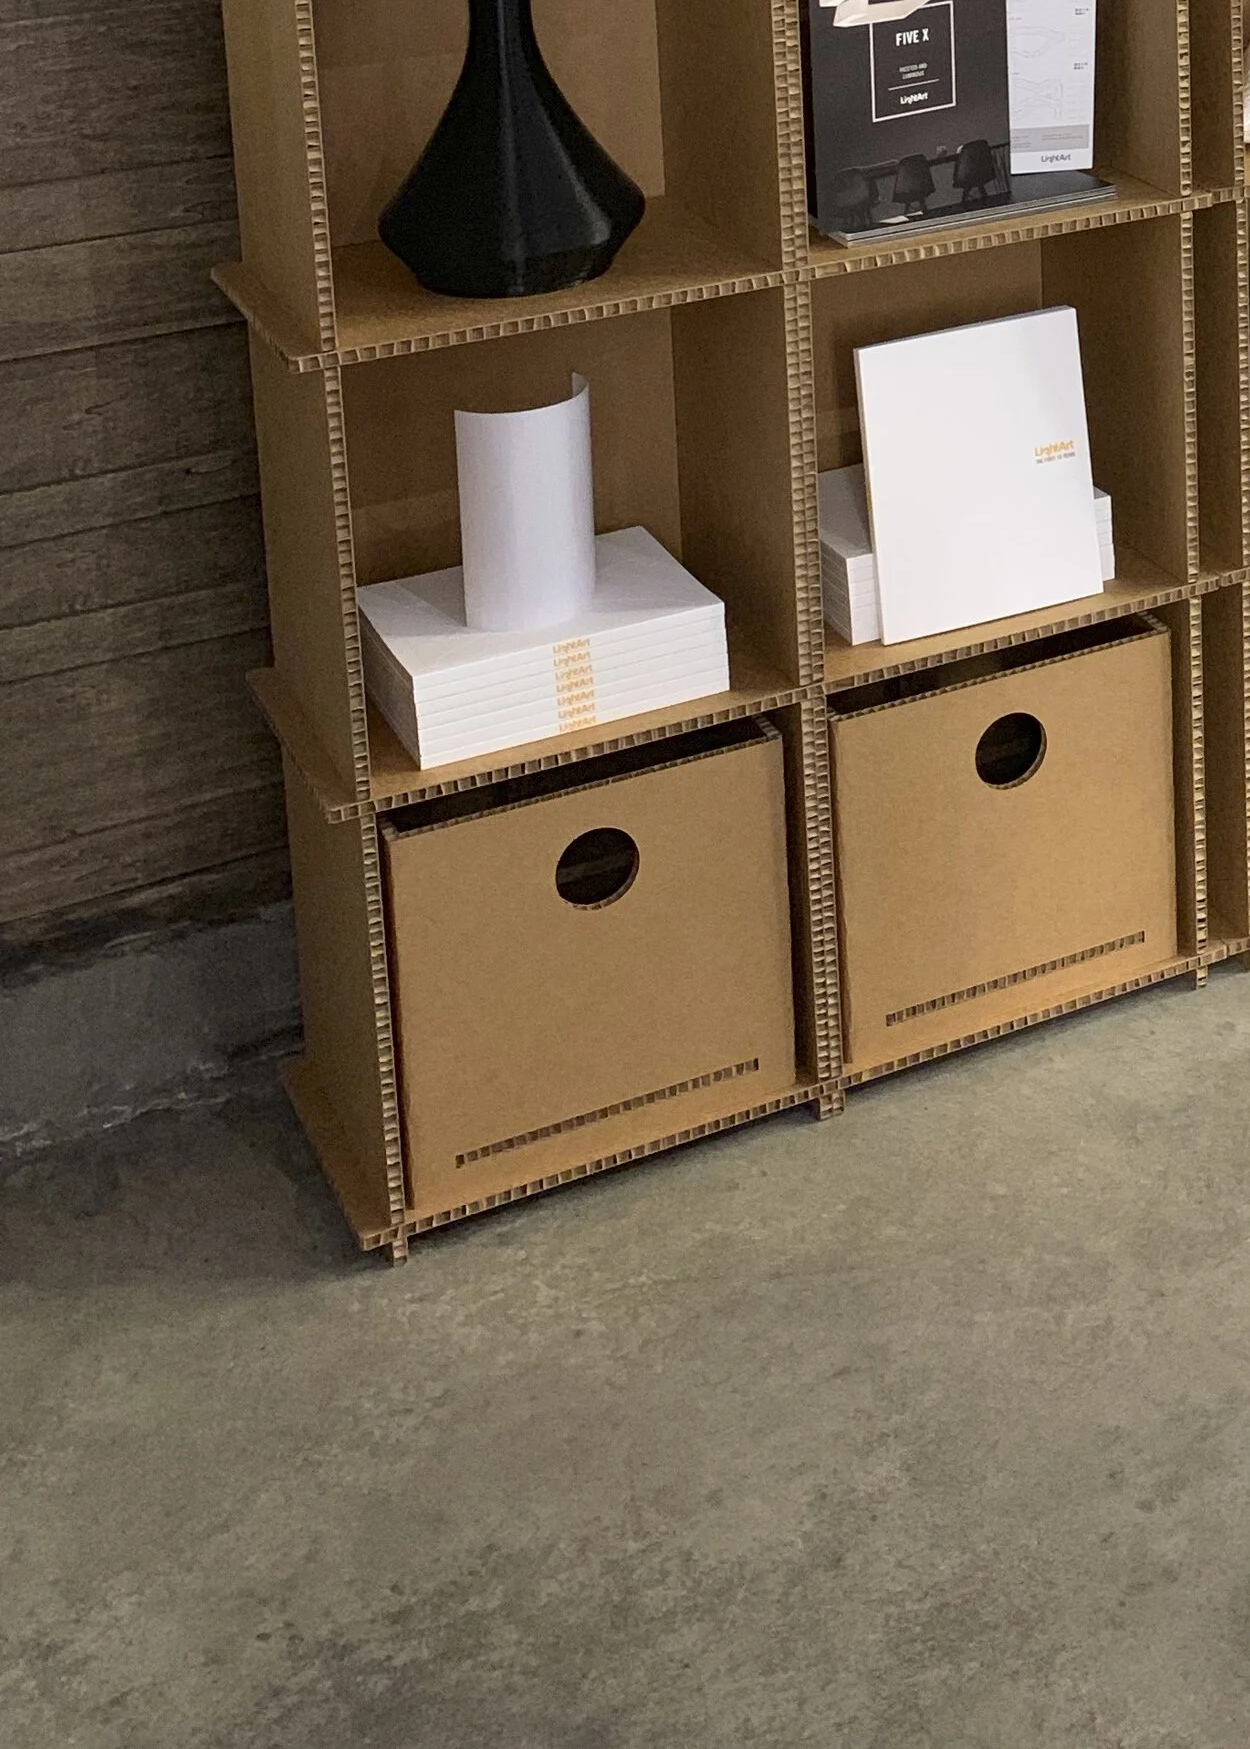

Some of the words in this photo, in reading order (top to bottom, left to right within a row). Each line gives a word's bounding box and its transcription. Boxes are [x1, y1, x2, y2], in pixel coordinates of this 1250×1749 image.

[895, 30, 919, 47] FIVE
[922, 28, 930, 42] X
[900, 92, 928, 105] LightArt
[1040, 154, 1071, 164] LightArt
[1034, 439, 1073, 457] LightArt
